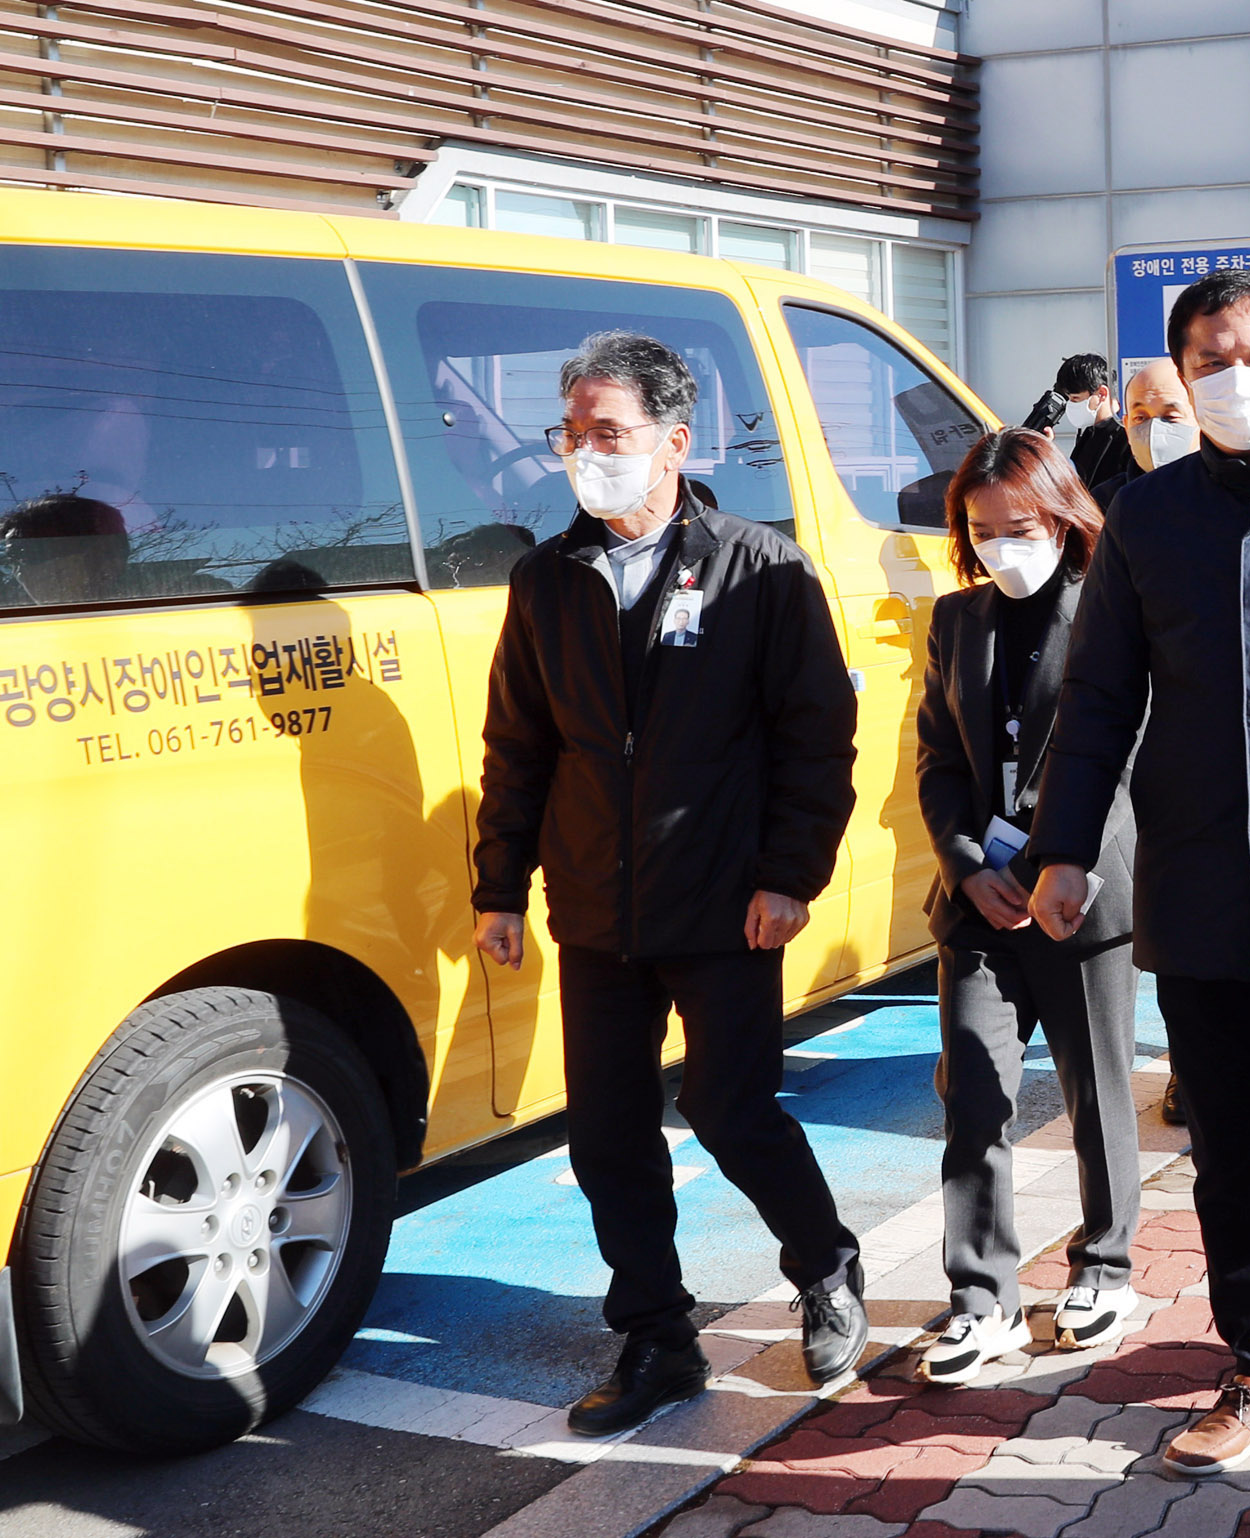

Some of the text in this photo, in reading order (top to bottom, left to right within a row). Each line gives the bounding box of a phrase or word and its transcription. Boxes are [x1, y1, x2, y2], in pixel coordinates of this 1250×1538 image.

[1132, 258, 1174, 278] 장애인
[1181, 257, 1209, 275] 전용
[0, 631, 402, 727] 광양시장애인직업재활시설
[78, 707, 332, 764] TEL. 061-761-9877
